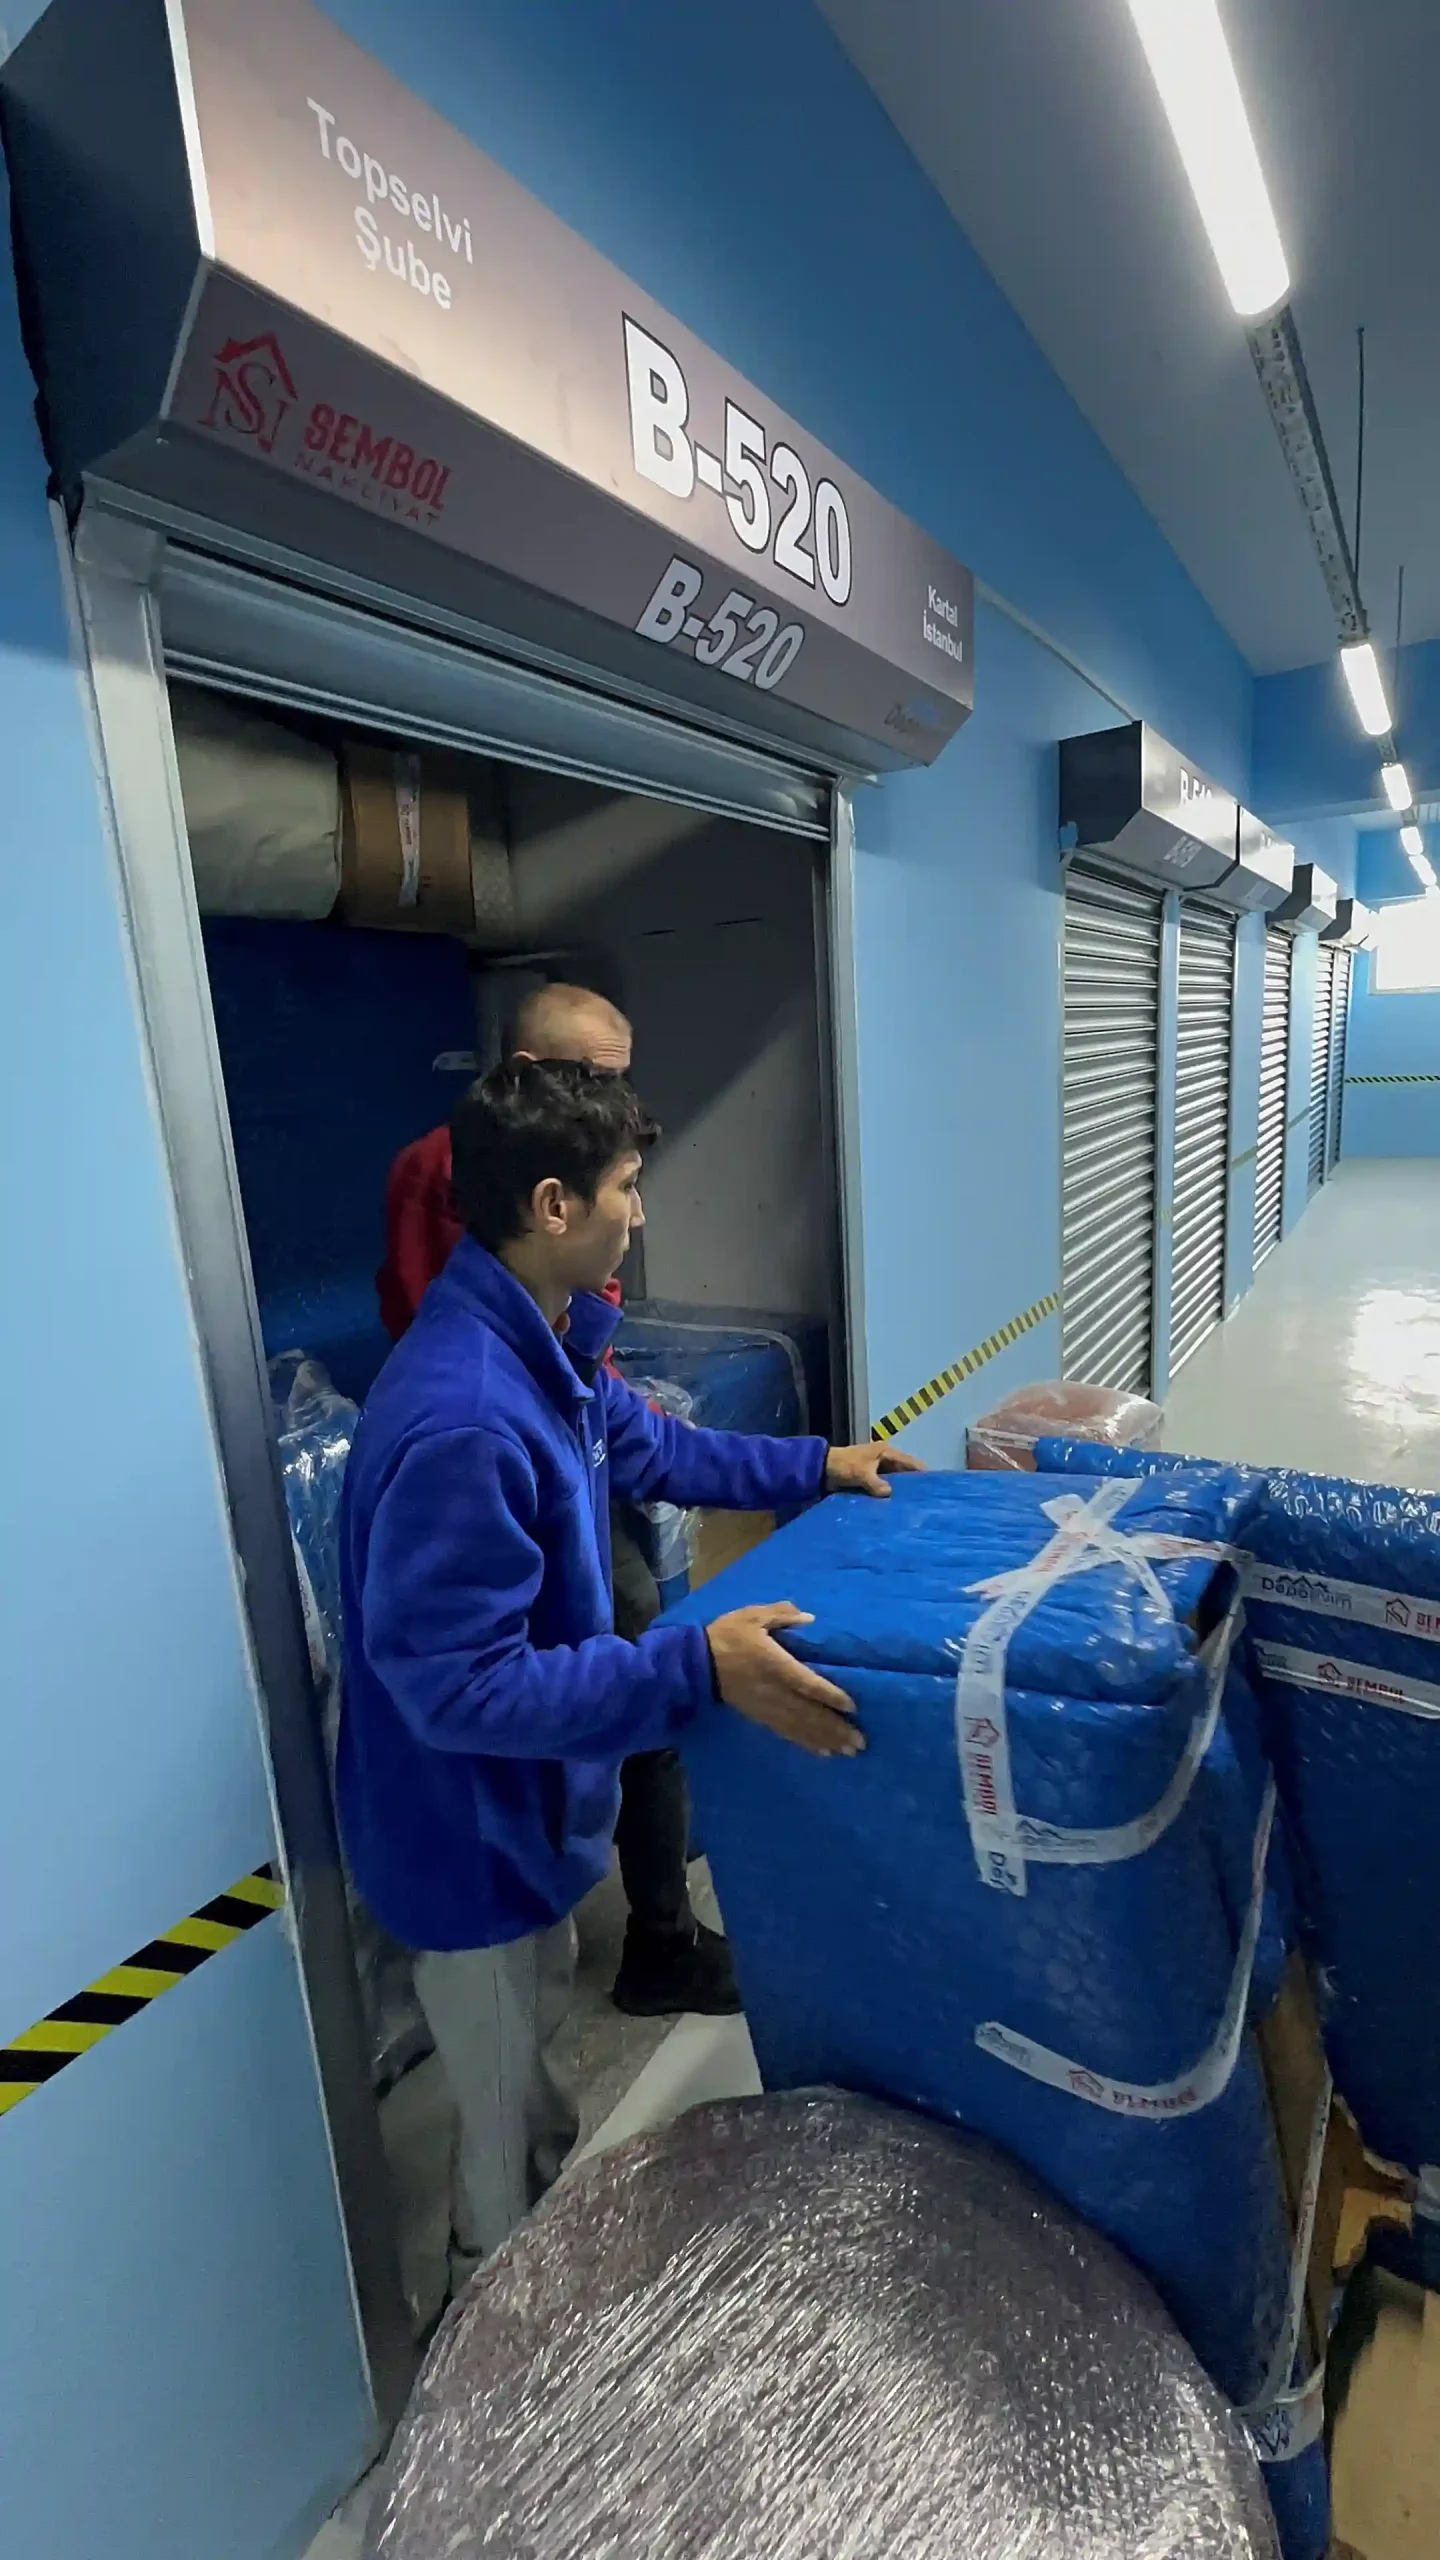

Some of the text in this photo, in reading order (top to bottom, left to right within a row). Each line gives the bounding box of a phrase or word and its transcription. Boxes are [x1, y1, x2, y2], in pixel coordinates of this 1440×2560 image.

[306, 96, 474, 265] Topselvi
[353, 205, 452, 310] Şube
[304, 403, 452, 511] SEMBOL
[622, 311, 853, 607] B-520
[633, 553, 805, 692] B-520
[922, 609, 963, 663] İstanbul
[927, 584, 958, 628] Kartal
